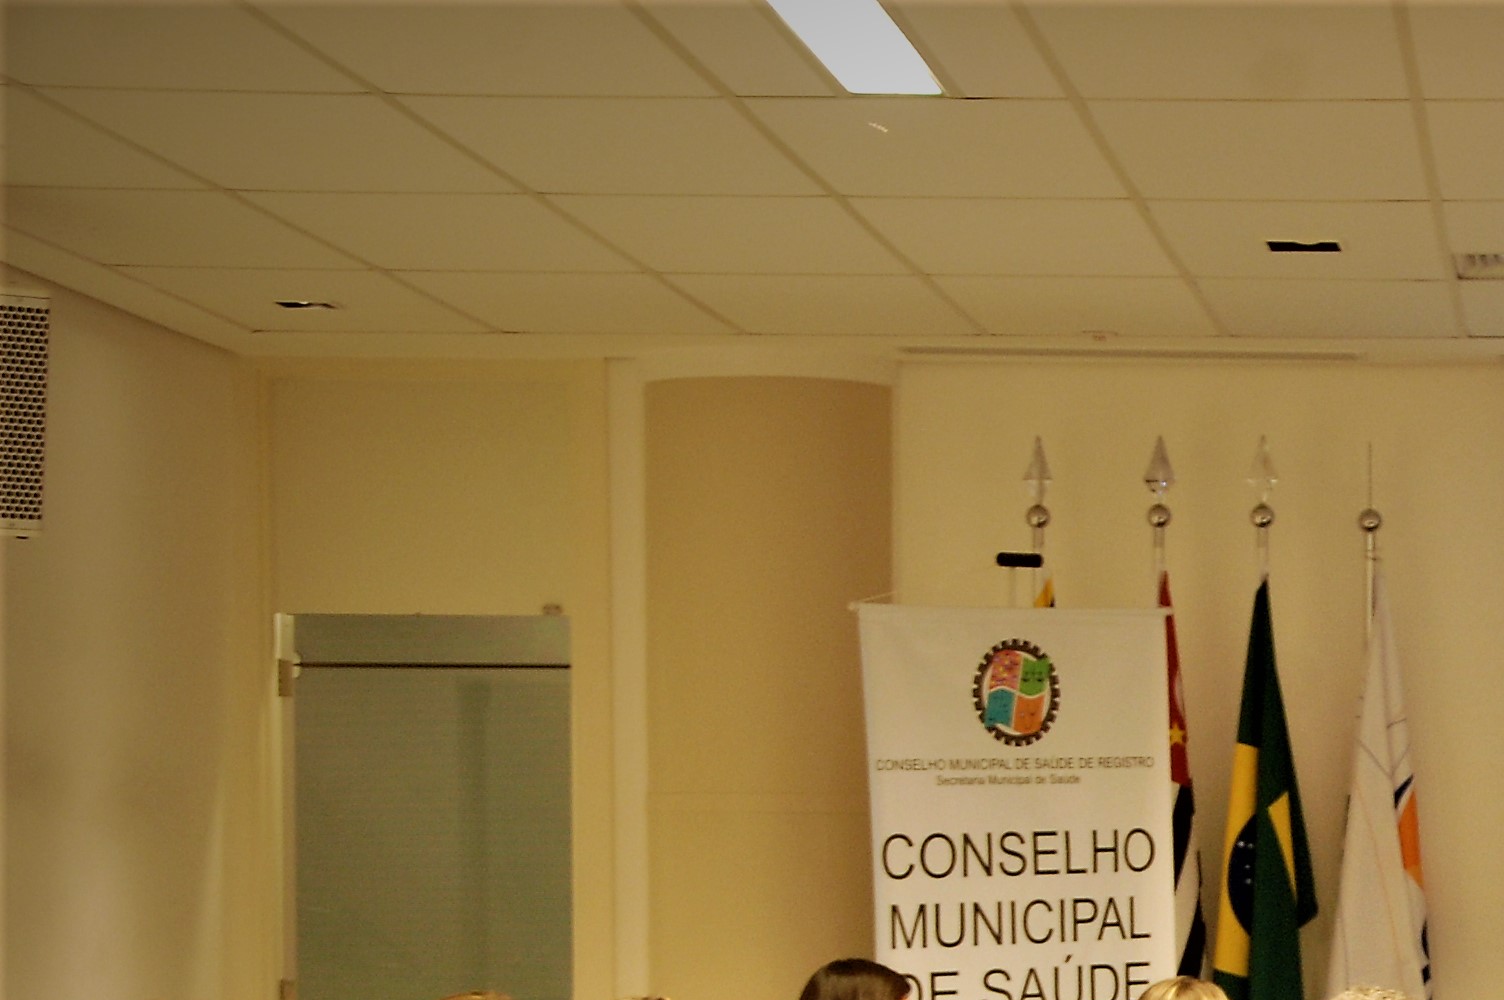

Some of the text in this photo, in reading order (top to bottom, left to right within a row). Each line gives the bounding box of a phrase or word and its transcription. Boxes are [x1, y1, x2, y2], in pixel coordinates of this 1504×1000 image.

[876, 758, 946, 771] CONSELHO
[949, 758, 1012, 771] MUNICIPAL
[1015, 757, 1030, 770] DE
[1079, 756, 1095, 769] DE
[1098, 756, 1154, 769] REGISTRO
[882, 828, 1155, 880] CONSELHO
[890, 896, 1152, 949] MUNICIPAL
